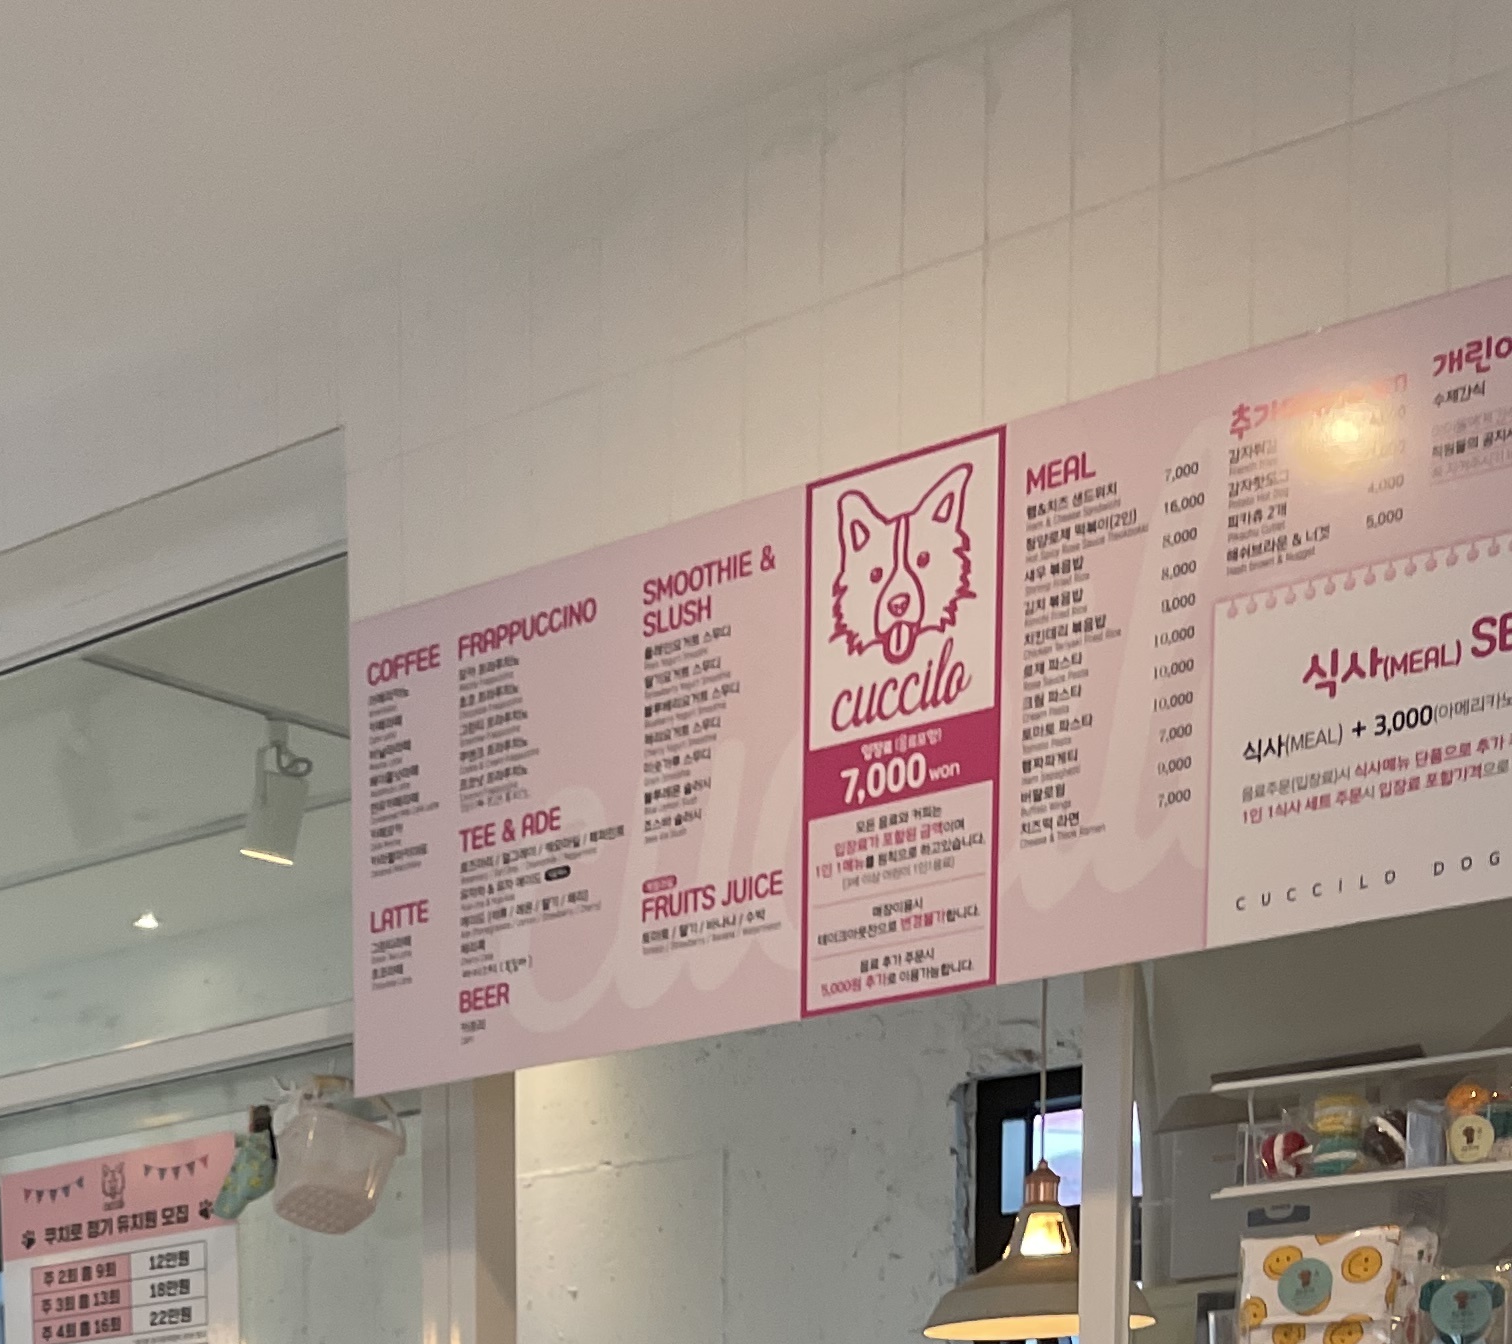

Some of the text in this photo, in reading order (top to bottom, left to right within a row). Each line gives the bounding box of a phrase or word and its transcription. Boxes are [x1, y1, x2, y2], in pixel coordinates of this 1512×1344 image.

[1434, 381, 1486, 408] 수제간식
[1025, 451, 1097, 495] MEAL
[1164, 461, 1199, 482] 7,000
[1163, 491, 1205, 515] 16,000
[1365, 507, 1404, 530] 5,000
[643, 545, 776, 605] SMOOTHIE &
[1050, 556, 1083, 576] 볶음밥
[1050, 588, 1083, 608] 볶음밥
[457, 597, 598, 661] FRAPPUCCINO
[643, 595, 712, 638] SLUSH
[1072, 614, 1106, 634] 볶음밥
[1153, 625, 1196, 648] 10,000
[366, 643, 442, 687] COFFEE
[1153, 658, 1195, 680] 10,000
[1301, 638, 1462, 699] 식사(MEAL)
[831, 637, 973, 732] cuccilo
[1152, 690, 1194, 713] 10,000
[1158, 722, 1193, 744] 7,000
[1242, 723, 1344, 763] 식사(MEAL)
[1351, 720, 1367, 737] +
[1475, 734, 1504, 754] 추가
[840, 752, 961, 805] 7,000 won
[1157, 788, 1192, 809] 7,000
[1242, 807, 1262, 825] 1인
[1379, 775, 1420, 798] 입장료
[458, 805, 562, 853] TEE & ADE
[1235, 850, 1501, 911] CUCCILO DOG
[642, 884, 715, 921] FRUITS
[720, 870, 782, 905] JUICE
[369, 899, 430, 934] LATTE
[458, 982, 511, 1014] BEER
[44, 1203, 188, 1245] 쿠치로 정기 유치원 모집
[149, 1249, 190, 1271] 12만원
[43, 1271, 54, 1287] 주
[57, 1268, 78, 1284] 2회
[96, 1261, 116, 1278] 9회
[41, 1298, 52, 1314] 주
[55, 1296, 75, 1312] 3회
[92, 1288, 120, 1308] 13회
[41, 1326, 52, 1341] 주
[56, 1323, 76, 1339] 4회
[94, 1317, 120, 1334] 16회
[150, 1305, 192, 1328] 22만원
